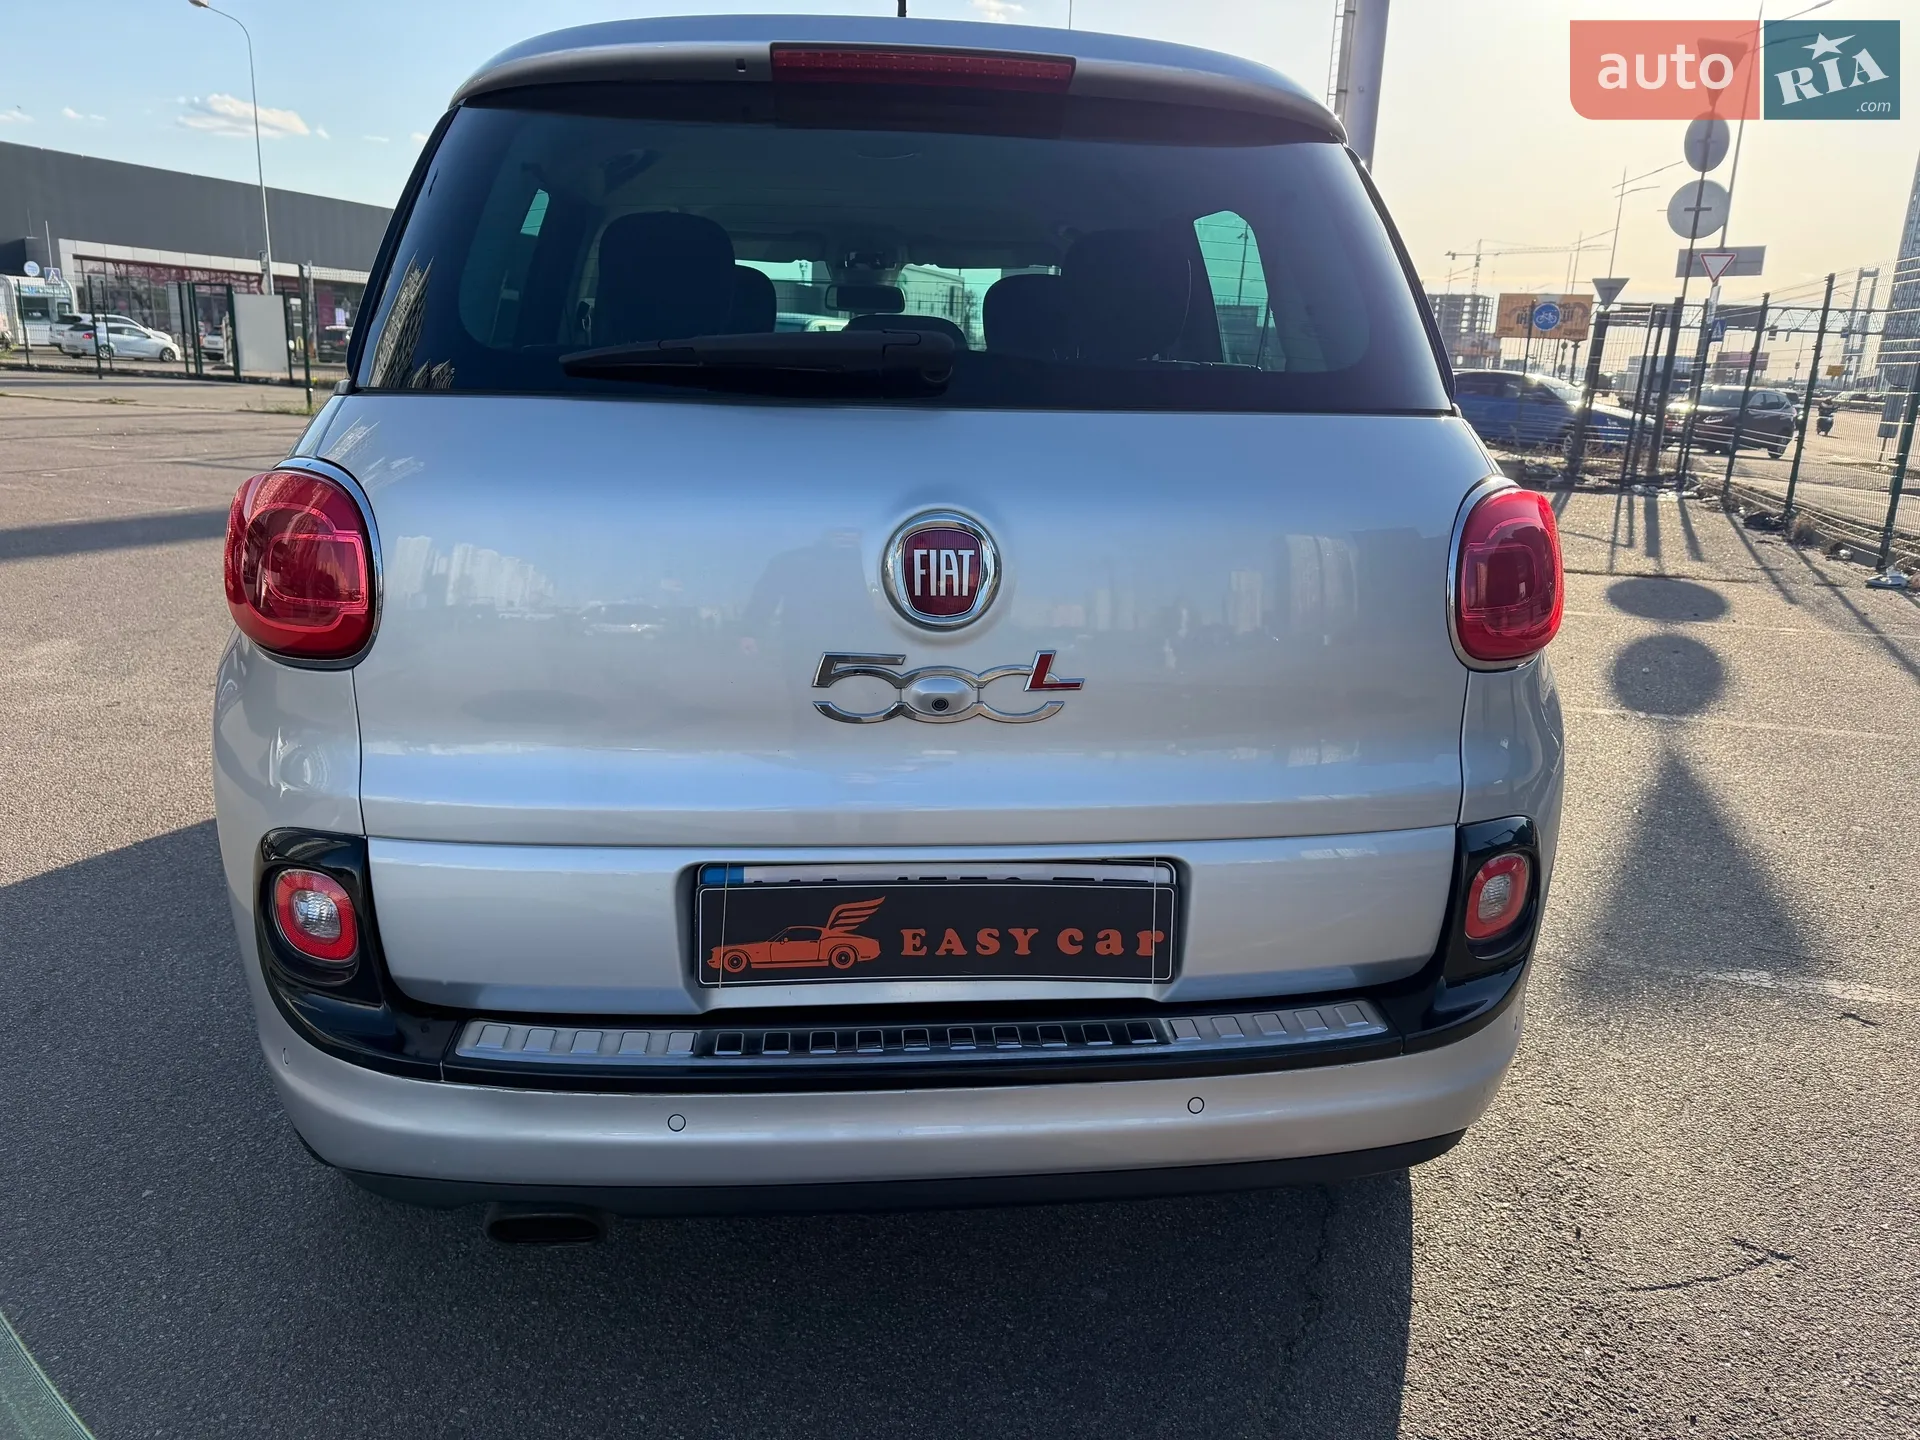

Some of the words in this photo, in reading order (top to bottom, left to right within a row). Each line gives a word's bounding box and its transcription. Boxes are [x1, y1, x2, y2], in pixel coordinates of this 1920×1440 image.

[913, 549, 975, 597] FIAT
[900, 927, 1039, 957] EASY
[1056, 928, 1165, 958] car
